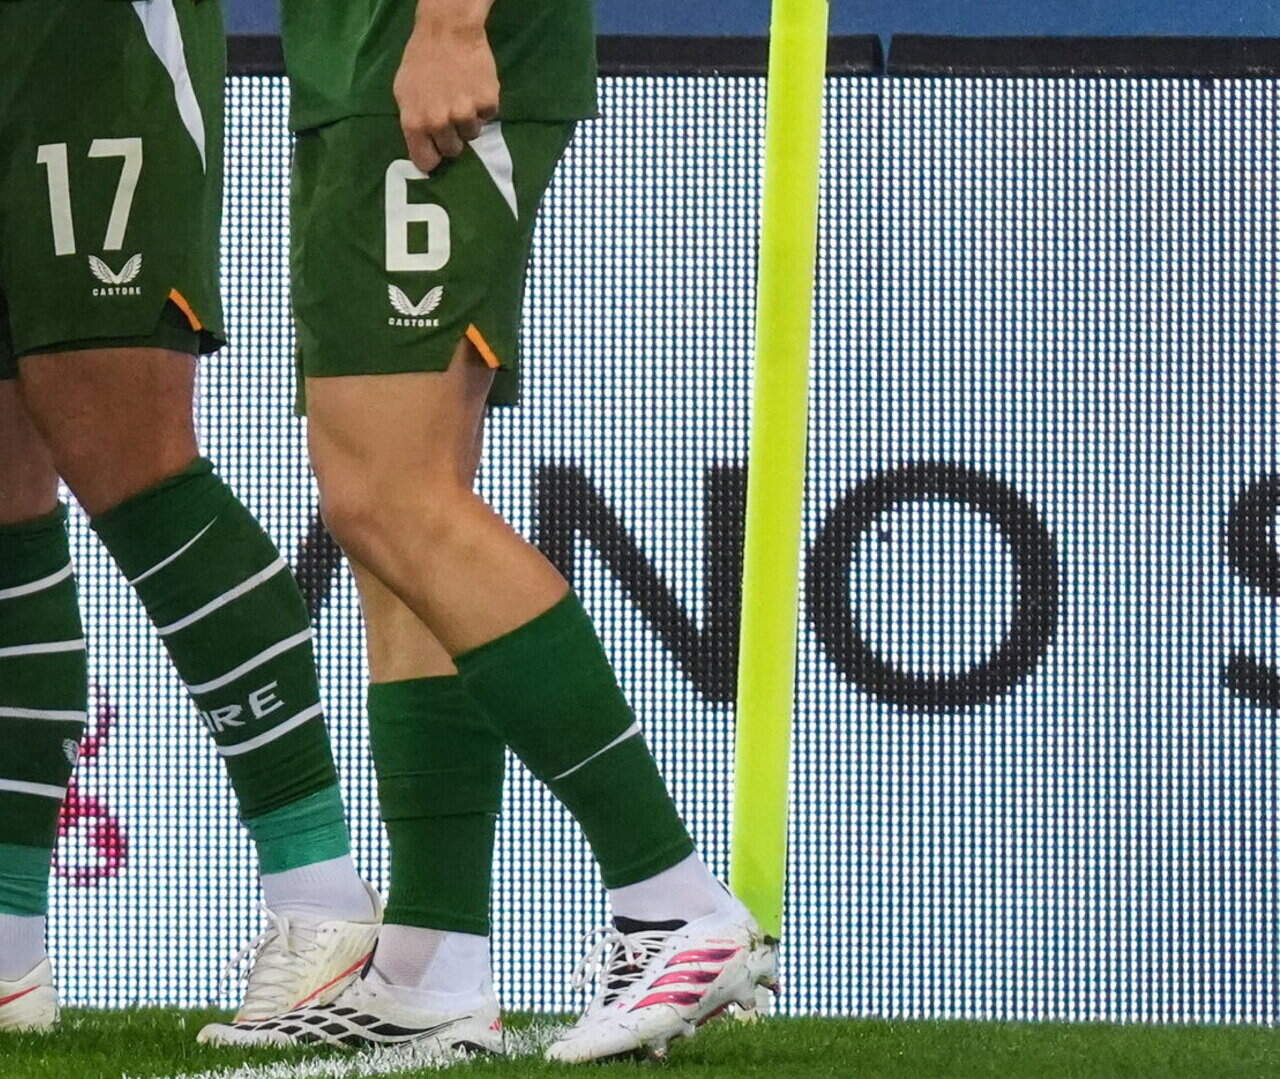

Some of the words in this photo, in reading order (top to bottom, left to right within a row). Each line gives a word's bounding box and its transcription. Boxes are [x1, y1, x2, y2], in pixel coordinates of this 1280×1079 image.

[36, 137, 143, 256] 17
[384, 159, 451, 272] 6
[92, 286, 141, 297] CASTORE
[388, 317, 440, 328] CASTORE
[295, 459, 1060, 715] NO
